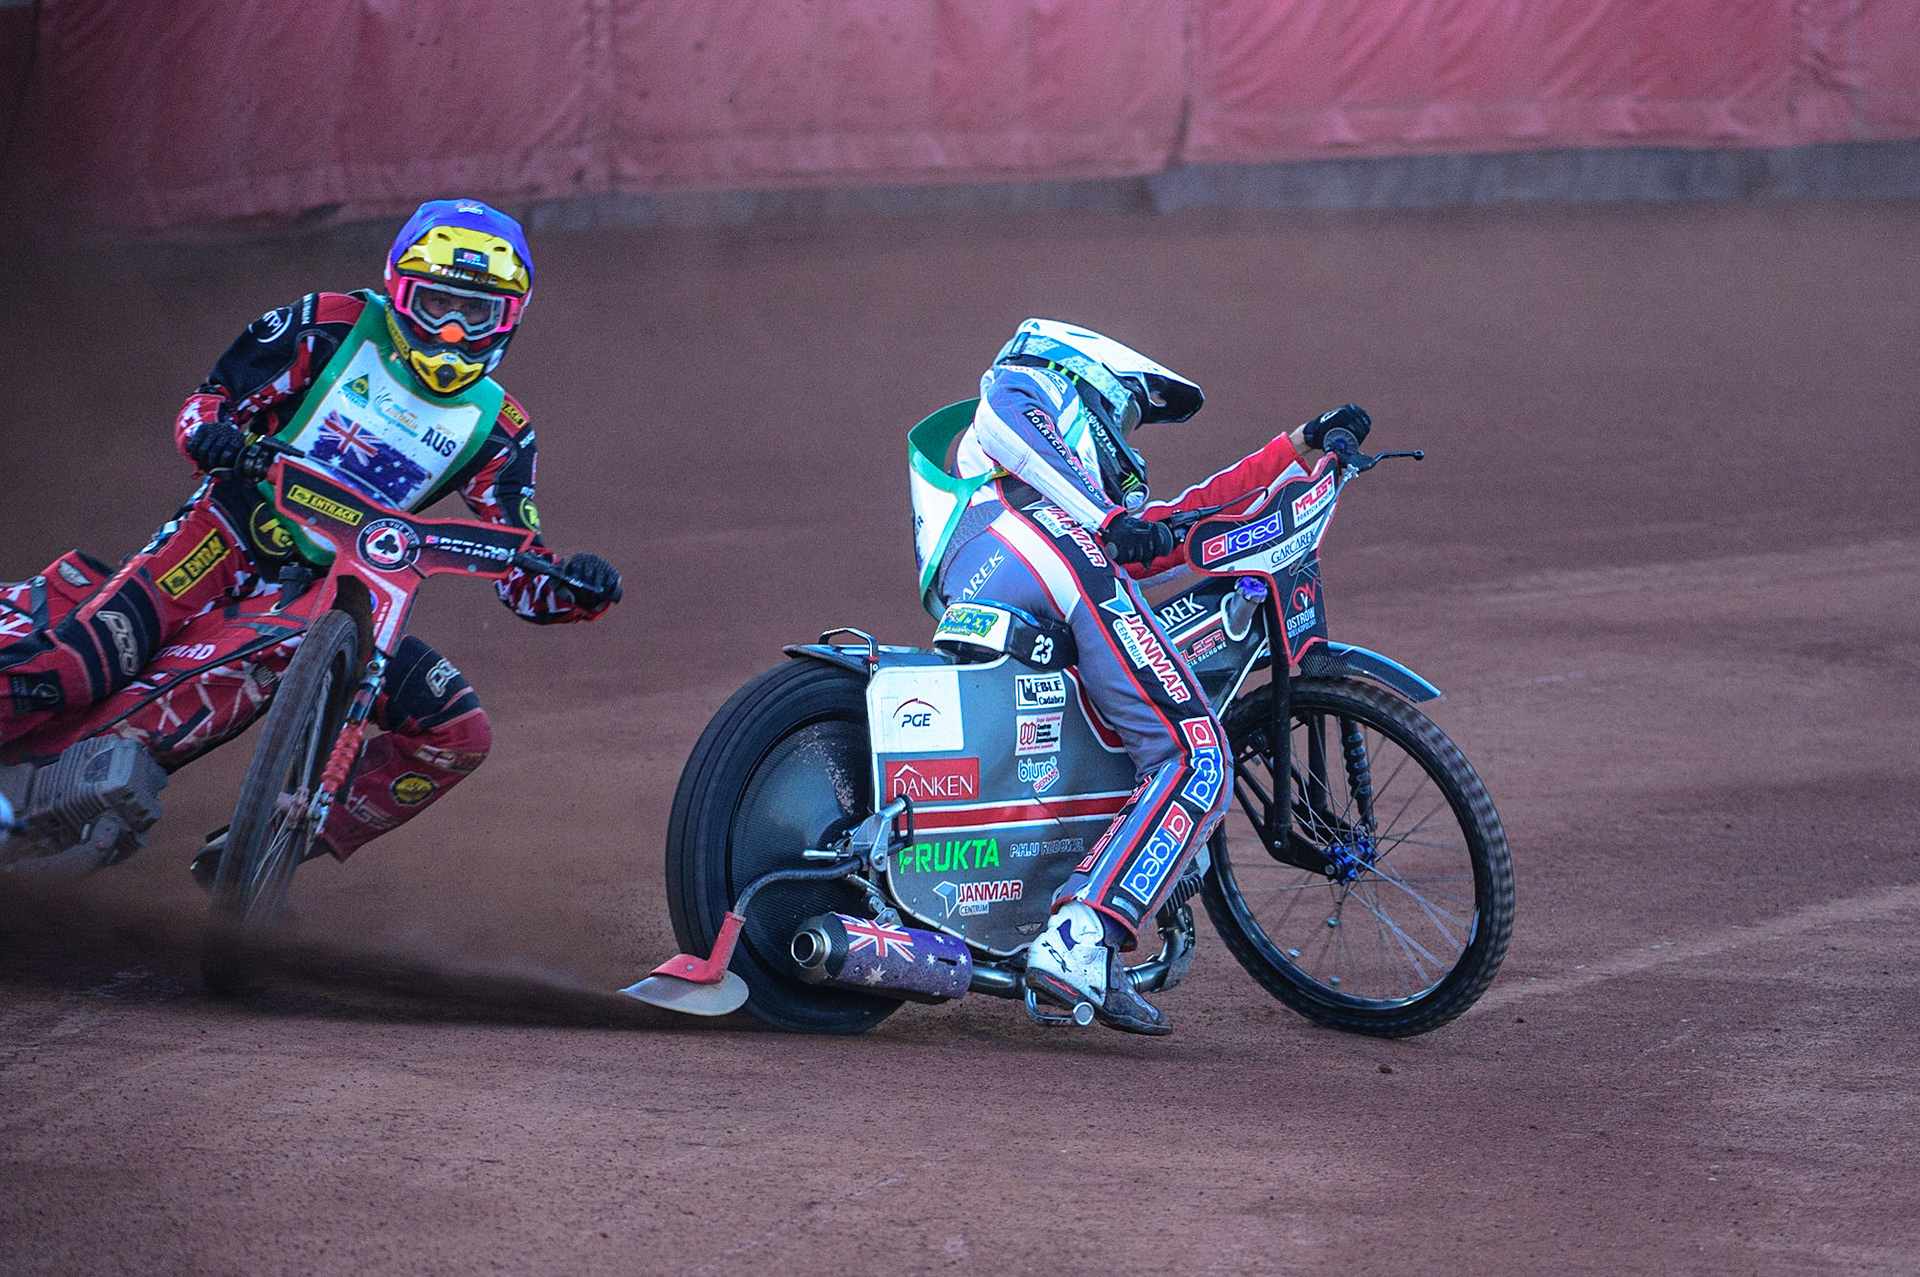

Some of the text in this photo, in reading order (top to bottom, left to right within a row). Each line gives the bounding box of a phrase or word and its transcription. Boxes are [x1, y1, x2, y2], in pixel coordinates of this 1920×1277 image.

[420, 427, 457, 457] AUS
[1026, 410, 1067, 457] POKRYCIA
[309, 496, 357, 522] ENTRACK
[1208, 511, 1281, 556] arged
[1031, 633, 1054, 665] 23
[1114, 620, 1146, 667] CENTRUM
[1124, 616, 1189, 701] JANMAR
[1198, 641, 1227, 662] DACHOWE
[901, 713, 932, 728] PGE
[1018, 758, 1056, 782] biuro
[893, 774, 974, 798] DANKEN
[899, 838, 1000, 875] FRUKTA
[1130, 814, 1187, 902] arged
[958, 880, 1023, 903] JANMAR
[960, 903, 988, 916] CENTRUM
